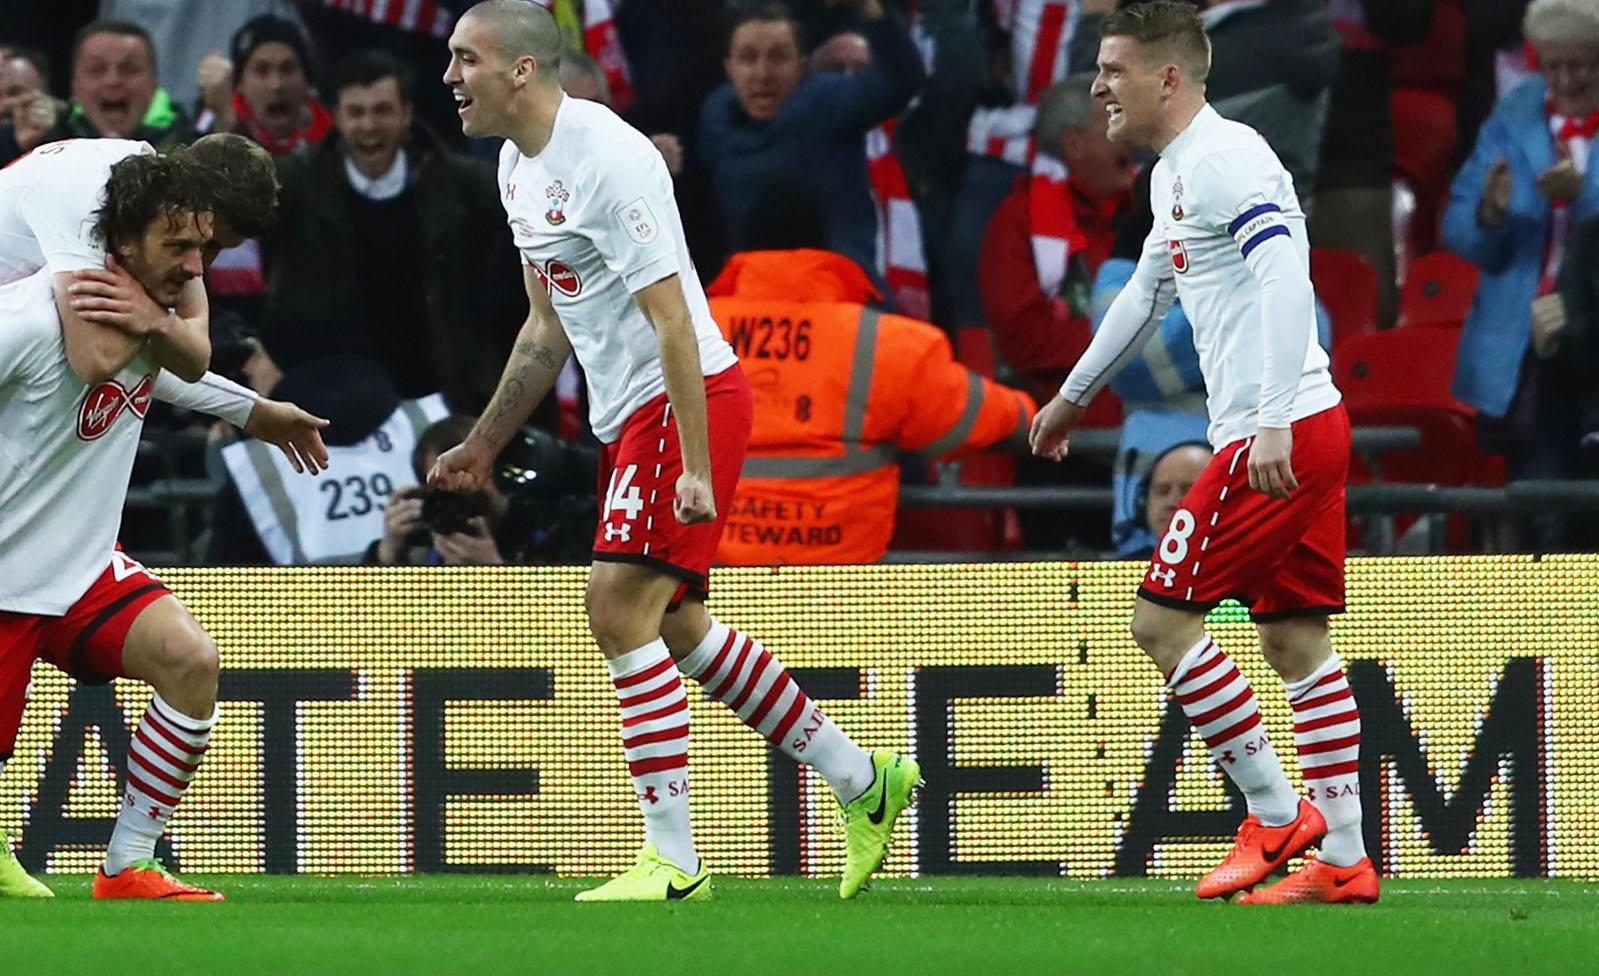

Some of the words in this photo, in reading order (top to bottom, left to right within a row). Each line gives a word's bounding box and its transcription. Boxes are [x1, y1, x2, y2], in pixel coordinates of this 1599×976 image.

[729, 317, 812, 362] W236
[319, 472, 395, 522] 239
[727, 522, 843, 546] TEWARD
[1158, 509, 1196, 564] 8
